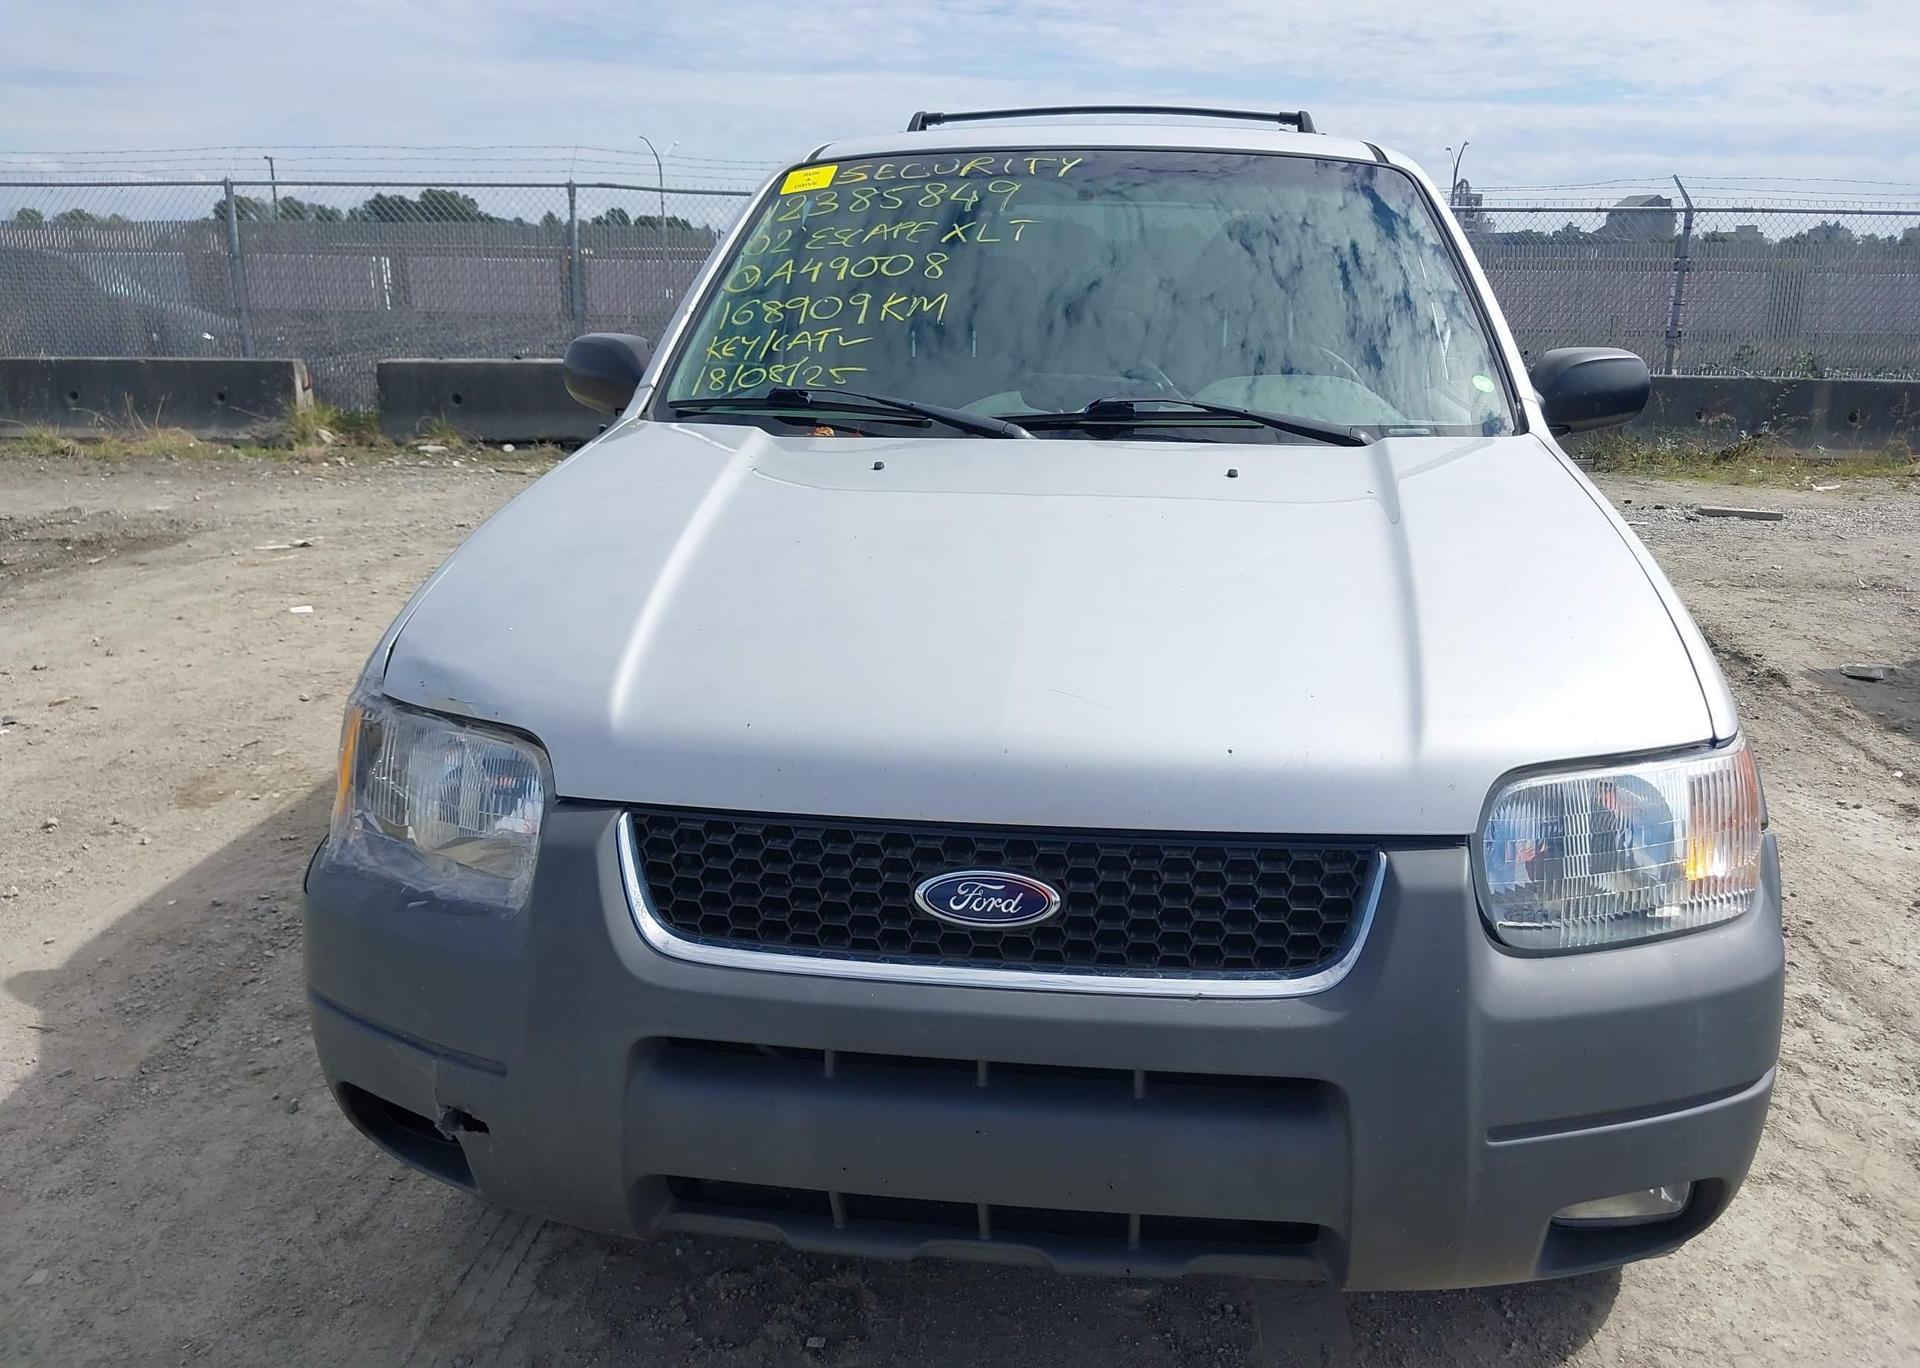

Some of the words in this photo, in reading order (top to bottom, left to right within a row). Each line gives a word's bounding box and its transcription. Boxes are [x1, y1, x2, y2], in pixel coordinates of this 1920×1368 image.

[833, 156, 1083, 186] SECURITY
[804, 221, 939, 250] ESCAPE
[940, 219, 1043, 244] XLT
[691, 356, 868, 397] 18/08/25
[949, 881, 1024, 914] Ford
